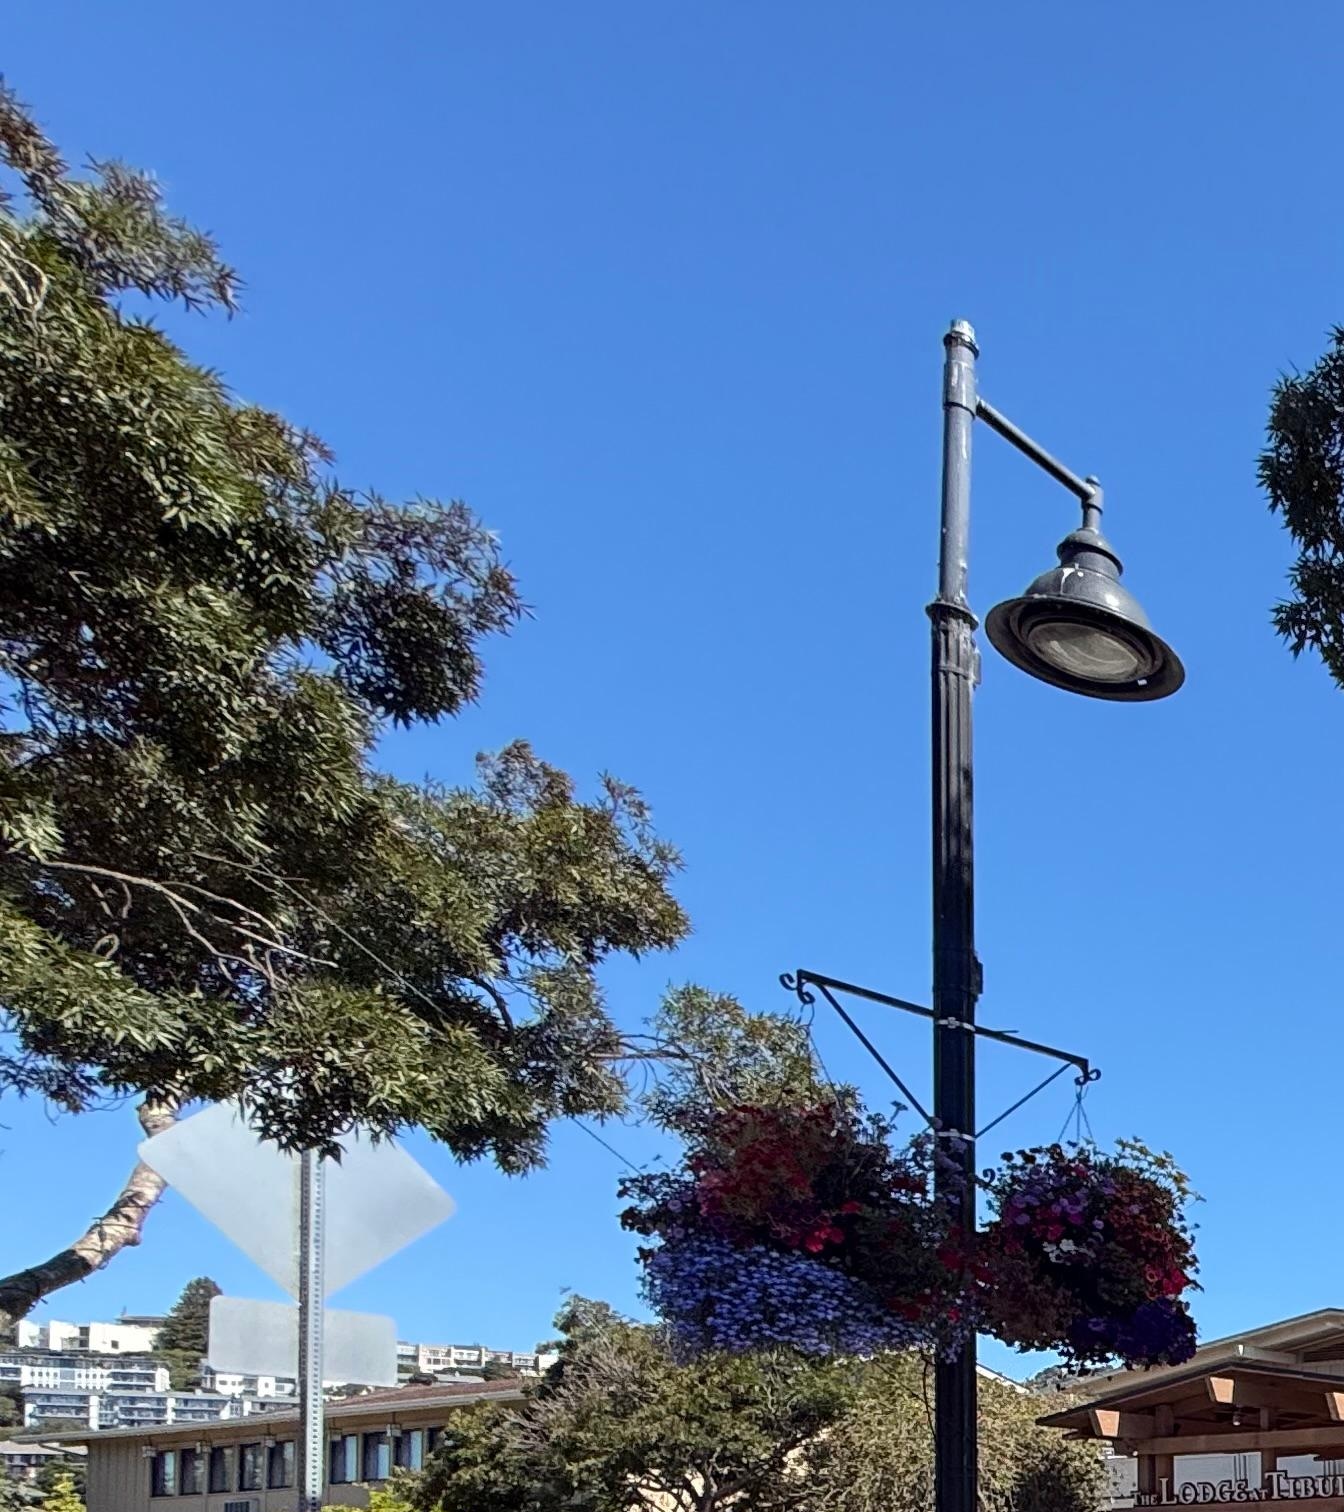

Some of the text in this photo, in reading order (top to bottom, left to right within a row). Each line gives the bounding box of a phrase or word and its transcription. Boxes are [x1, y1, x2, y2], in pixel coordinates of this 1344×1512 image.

[1132, 1490, 1158, 1505] THE
[1159, 1477, 1248, 1505] LODGE
[1250, 1487, 1268, 1501] AT
